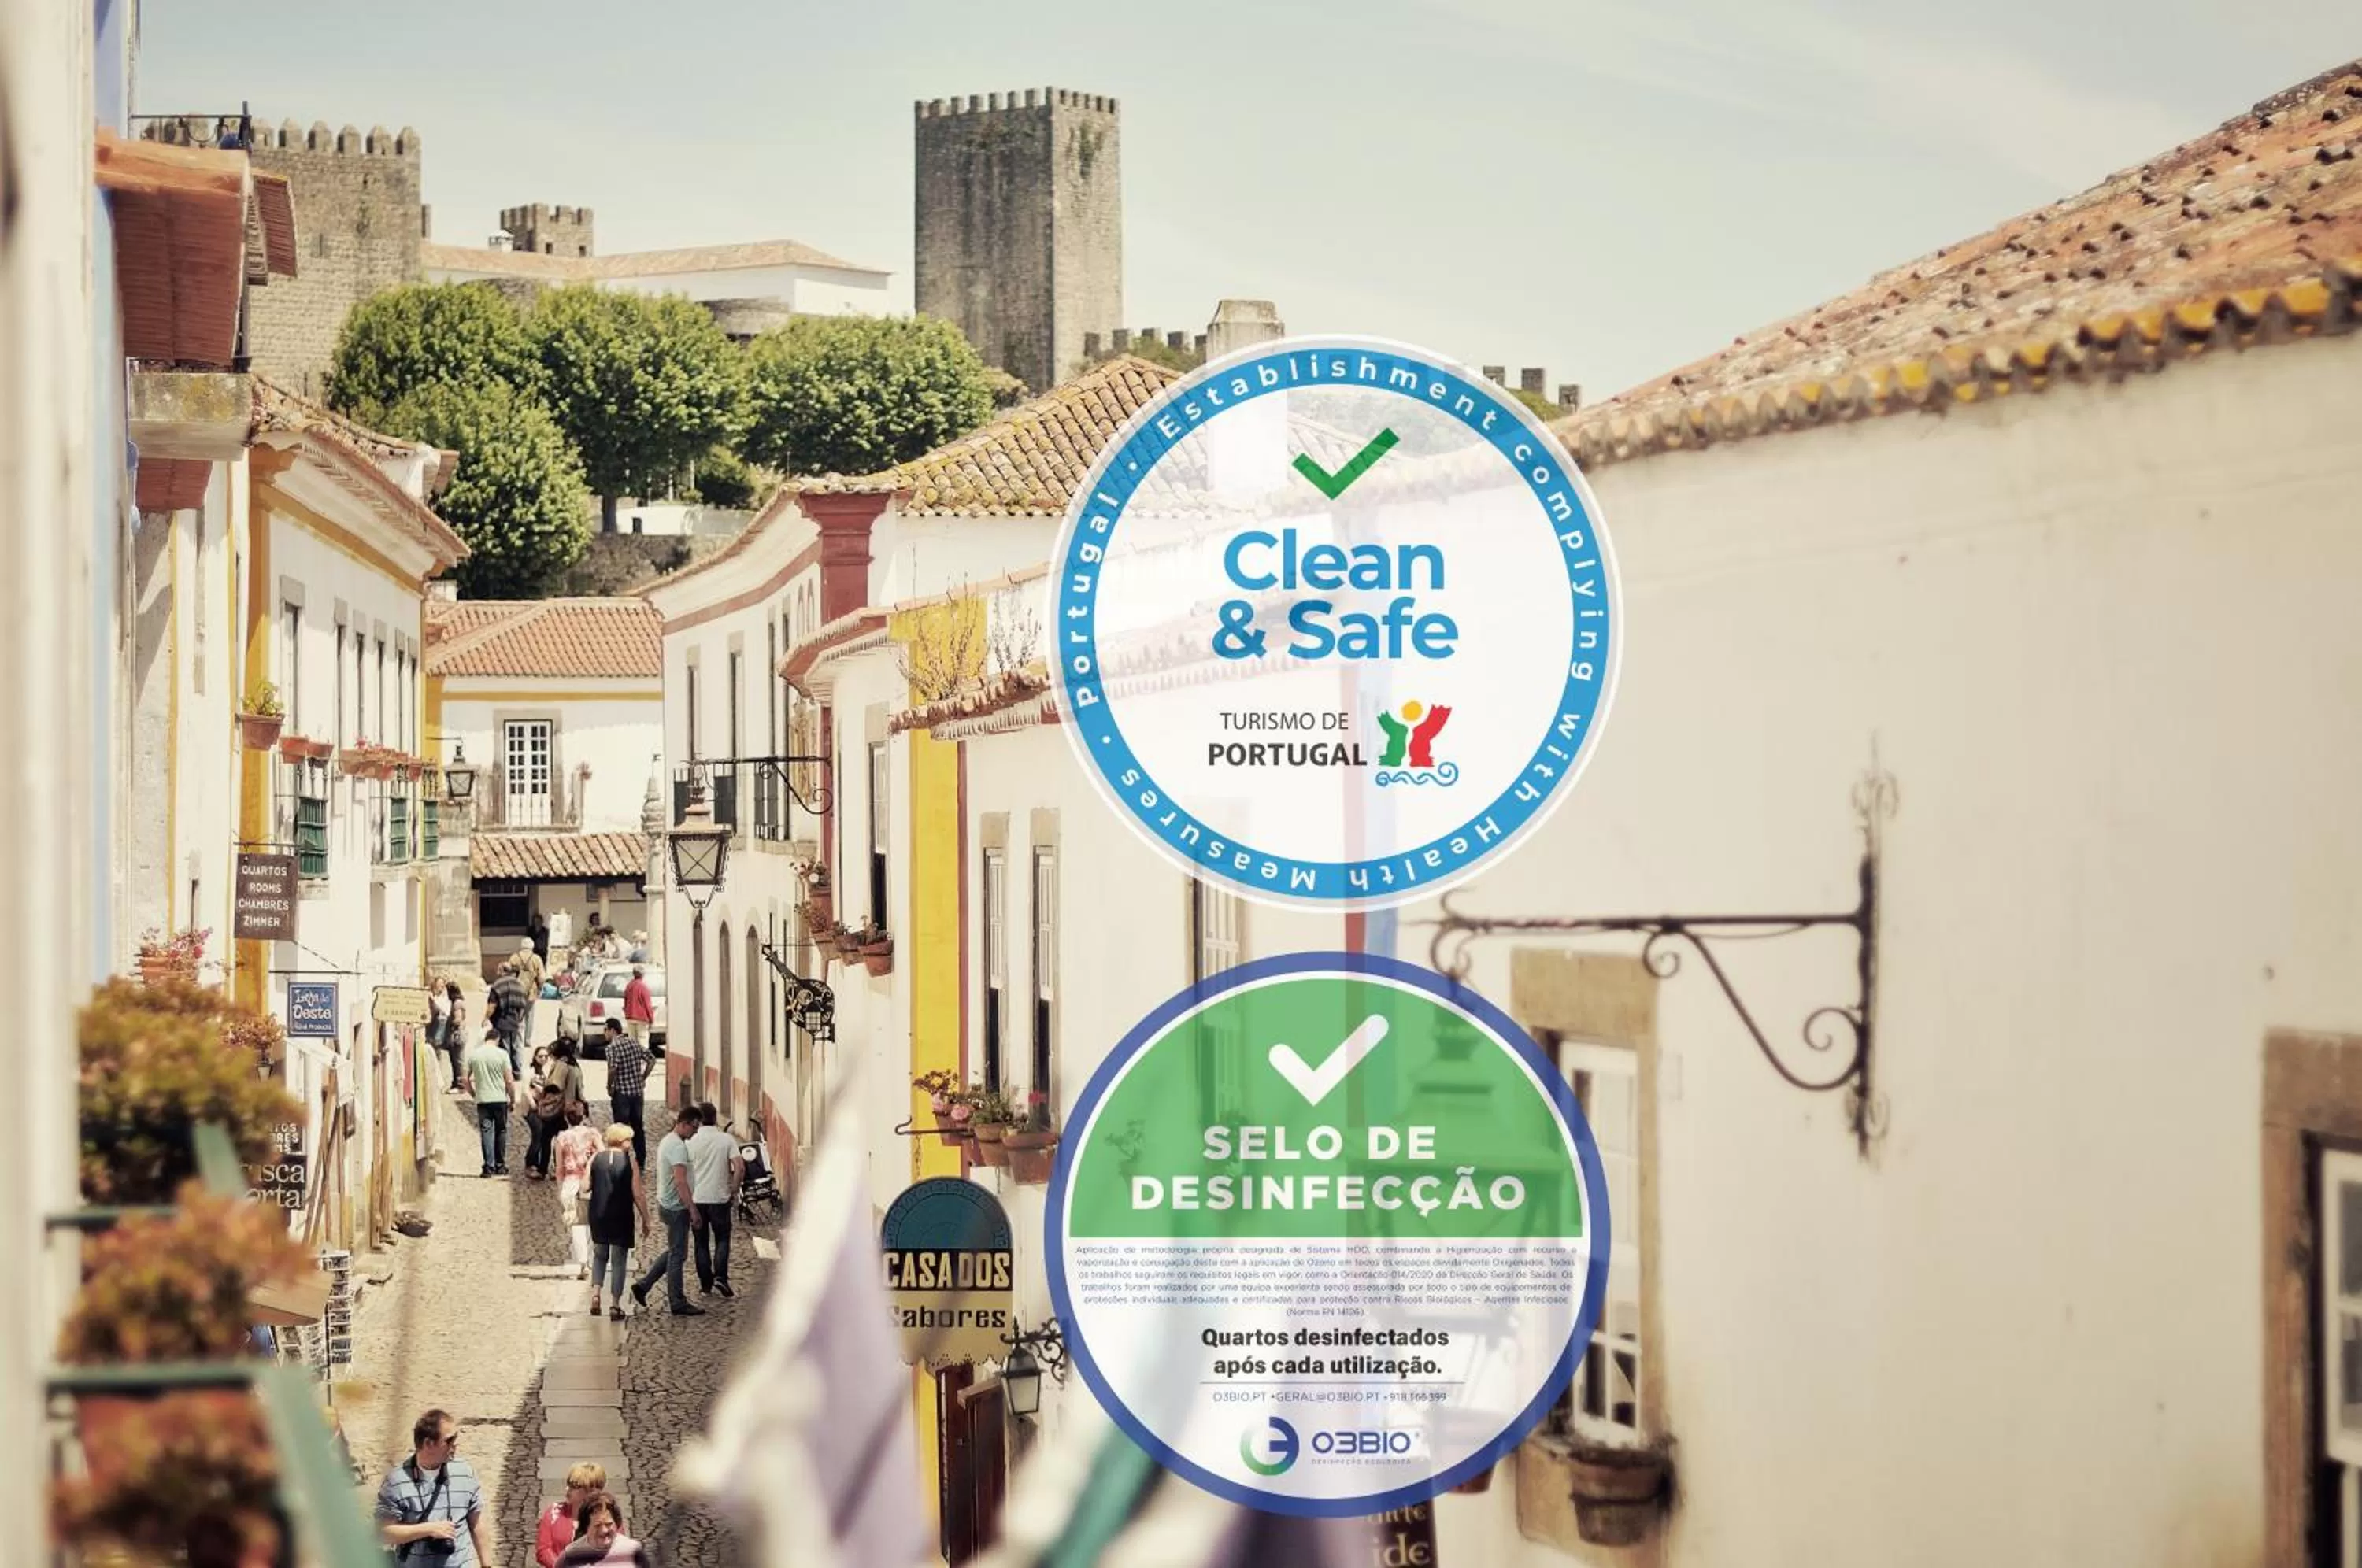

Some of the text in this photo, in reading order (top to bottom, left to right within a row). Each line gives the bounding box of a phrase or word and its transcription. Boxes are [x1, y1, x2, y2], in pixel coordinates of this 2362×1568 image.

[249, 882, 282, 893] ROOMS
[239, 898, 289, 911] CHAMBRES
[242, 915, 280, 926] ZIMMER
